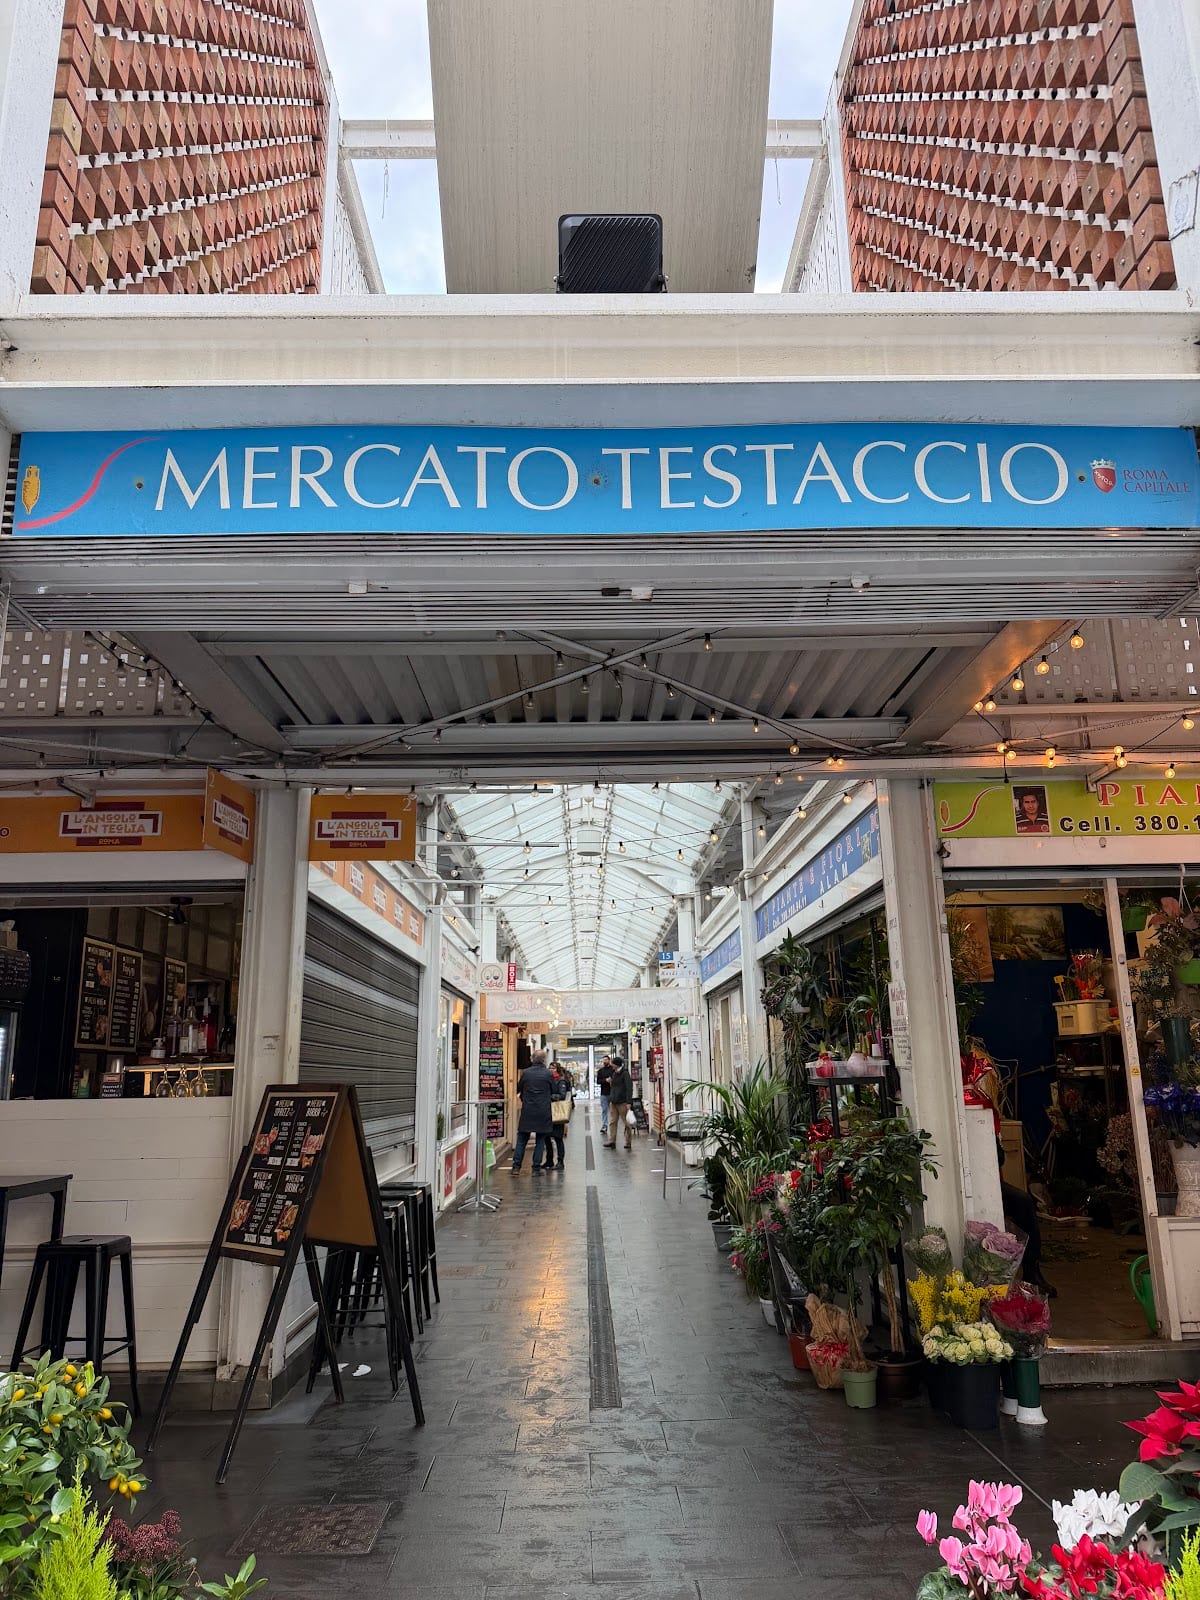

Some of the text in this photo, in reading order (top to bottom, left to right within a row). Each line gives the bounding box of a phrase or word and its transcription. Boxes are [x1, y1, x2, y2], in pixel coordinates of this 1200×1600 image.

[155, 441, 1069, 511] MERCATO TESTACCIO
[1123, 469, 1169, 481] ROMA
[1123, 481, 1192, 493] CAPITALE
[1099, 783, 1200, 806] PIA
[402, 797, 412, 812] 2
[74, 813, 137, 824] L'ANGOLO
[1060, 817, 1121, 832] Cell.
[82, 823, 146, 834] IN TEGLIA
[327, 821, 381, 830] L'ANGOLO
[334, 829, 389, 838] IN TEGLIA
[662, 952, 671, 960] 15
